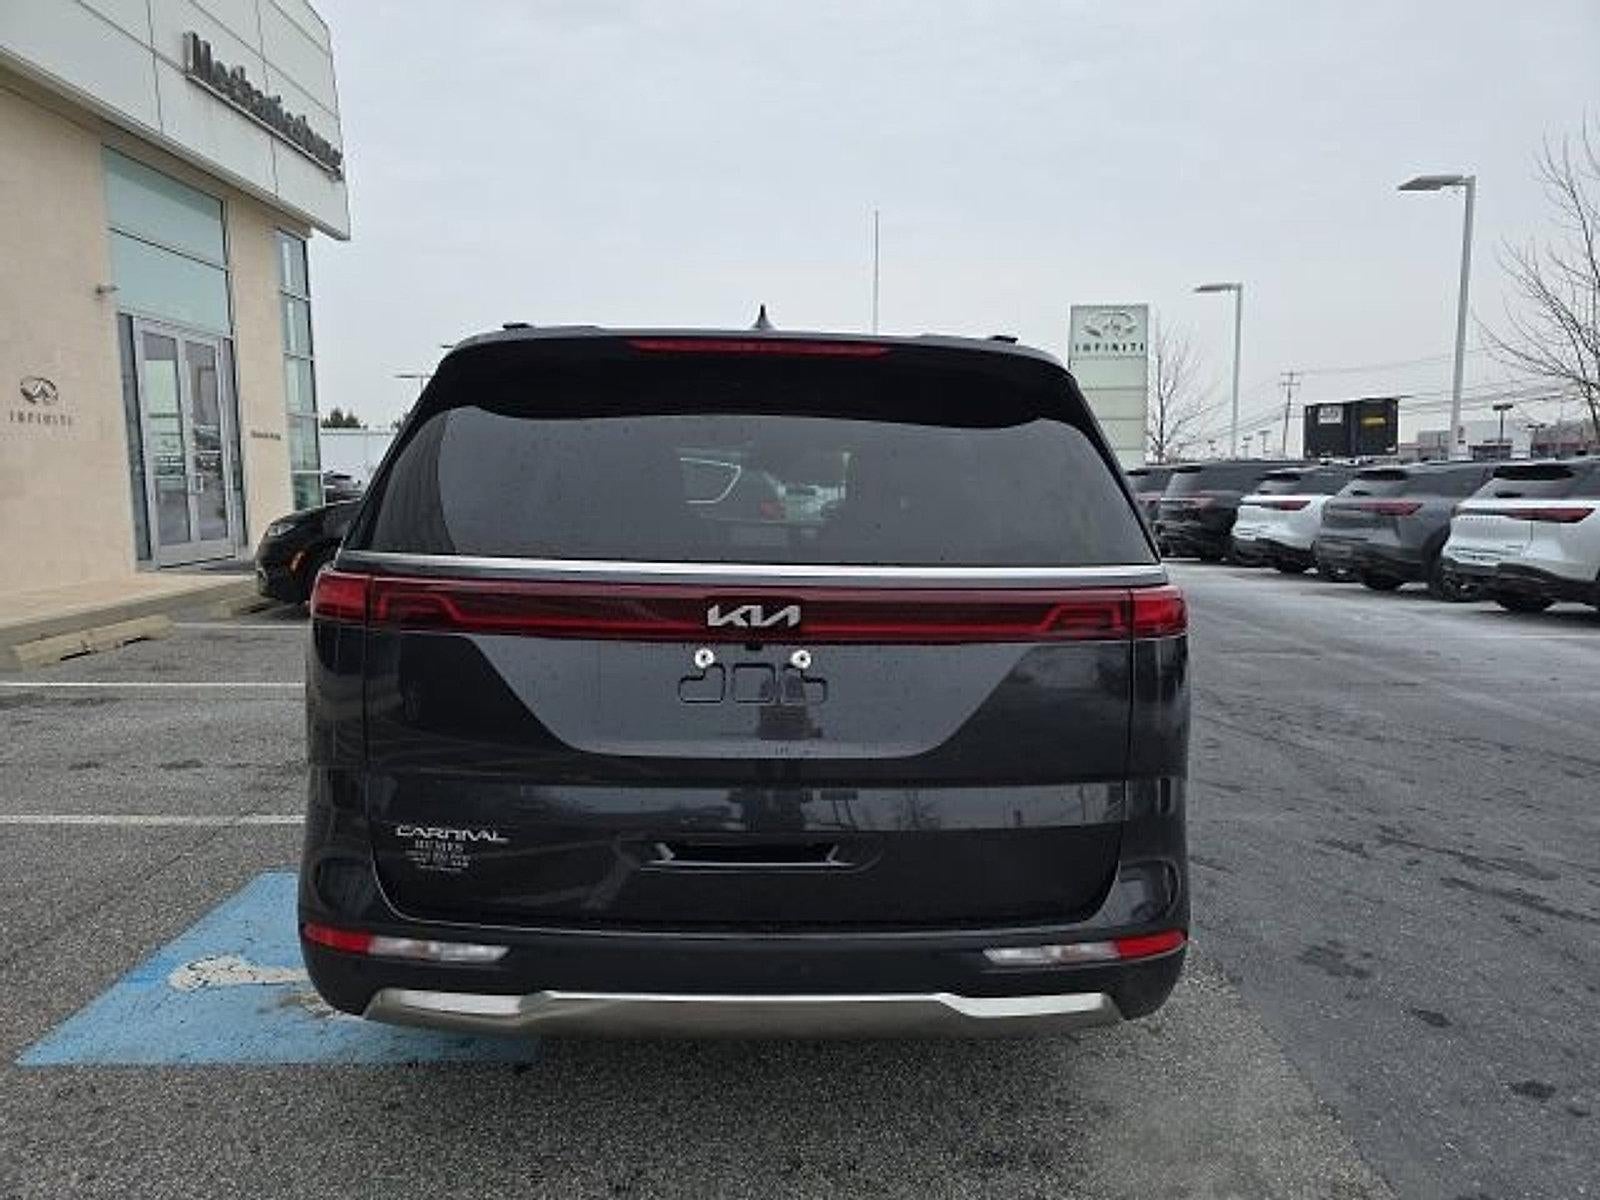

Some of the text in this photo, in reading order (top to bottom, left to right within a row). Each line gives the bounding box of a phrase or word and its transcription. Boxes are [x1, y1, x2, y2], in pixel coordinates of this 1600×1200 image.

[1074, 342, 1144, 352] INFINITI
[707, 604, 800, 627] KIA
[396, 824, 509, 843] CARNIVAL
